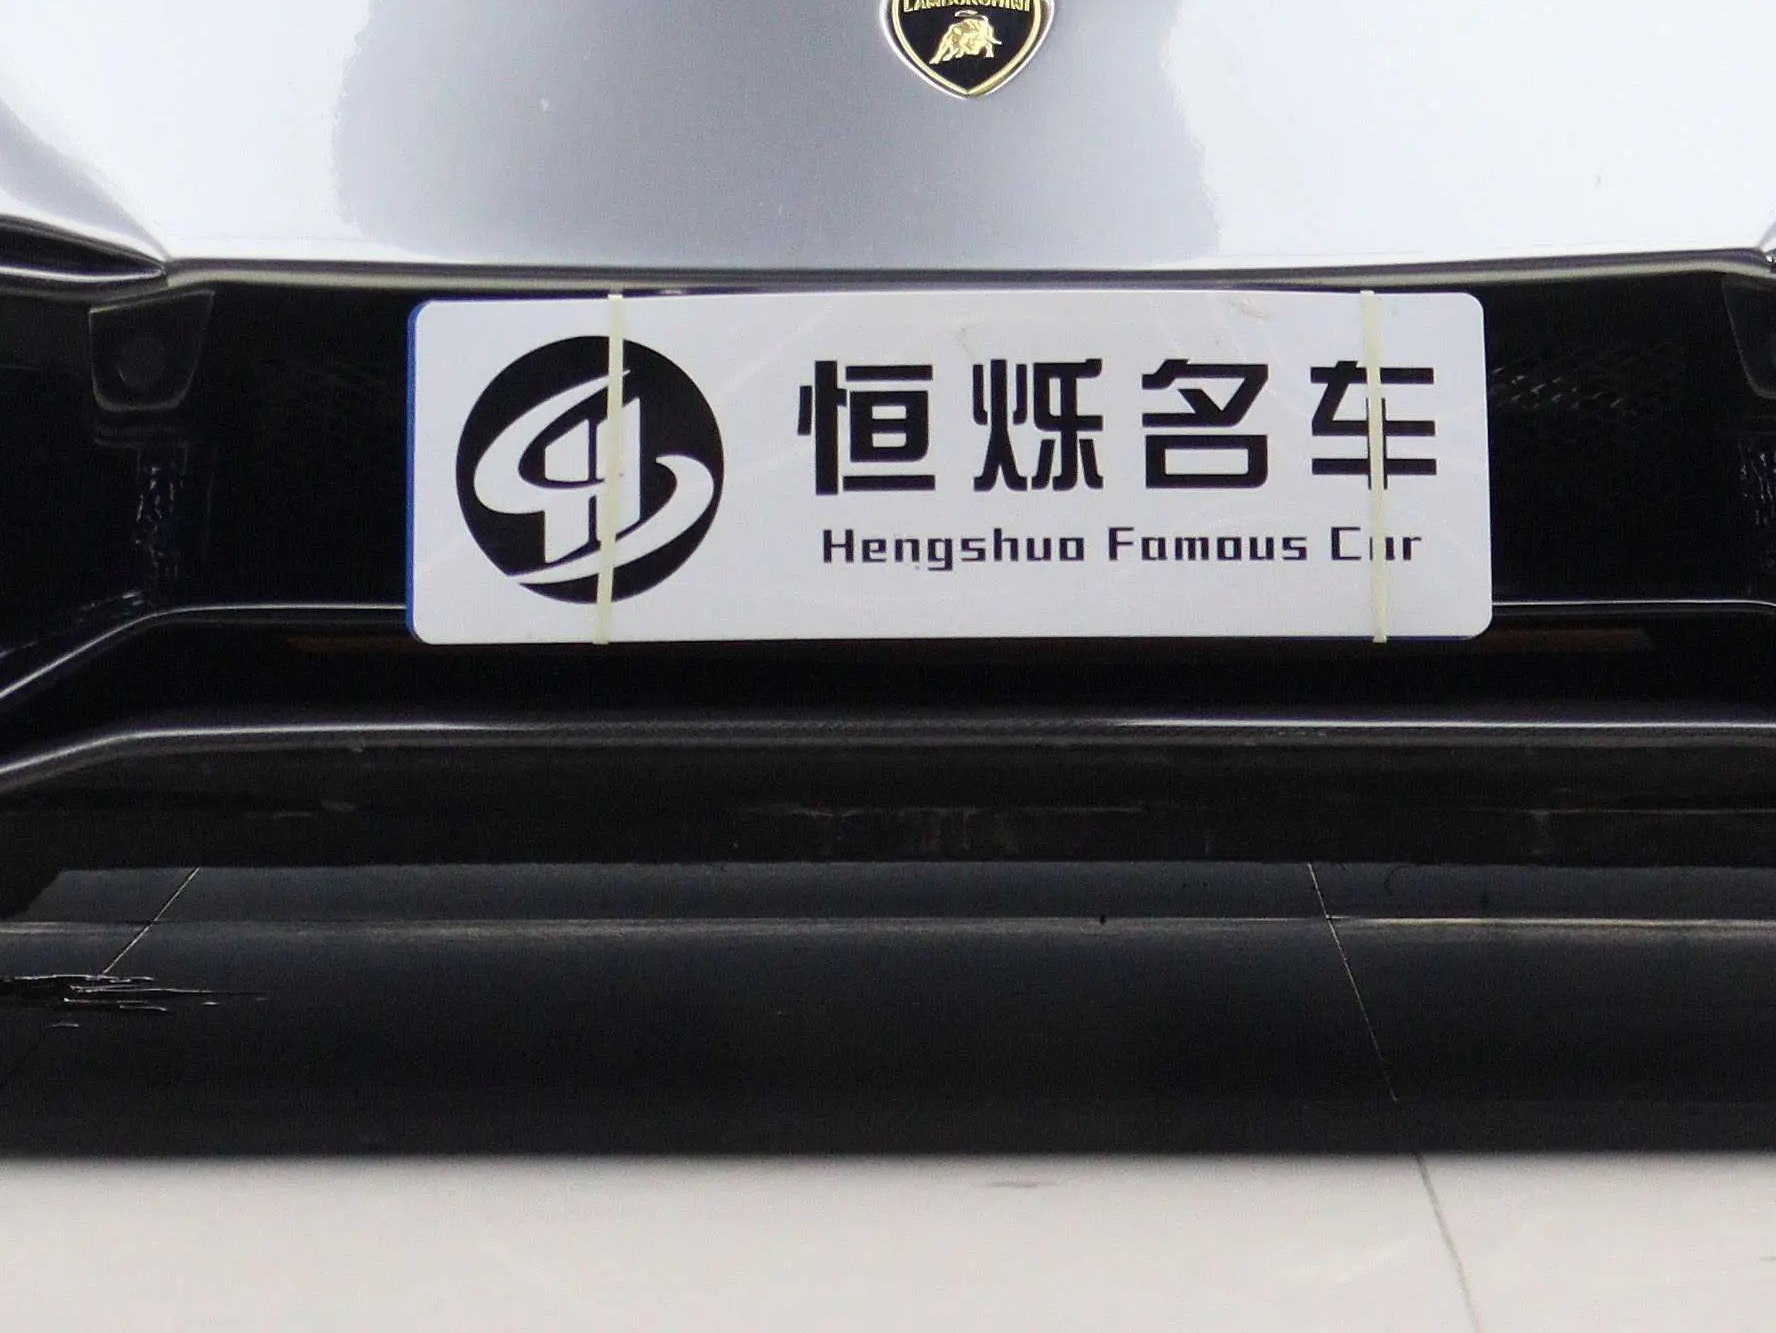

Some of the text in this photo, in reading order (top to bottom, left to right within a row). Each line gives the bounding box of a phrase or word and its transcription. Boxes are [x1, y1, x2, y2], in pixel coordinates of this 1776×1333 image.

[797, 358, 1437, 496] 恒烁名车
[823, 527, 1085, 571] Hengshuo
[1108, 526, 1308, 561] Famous
